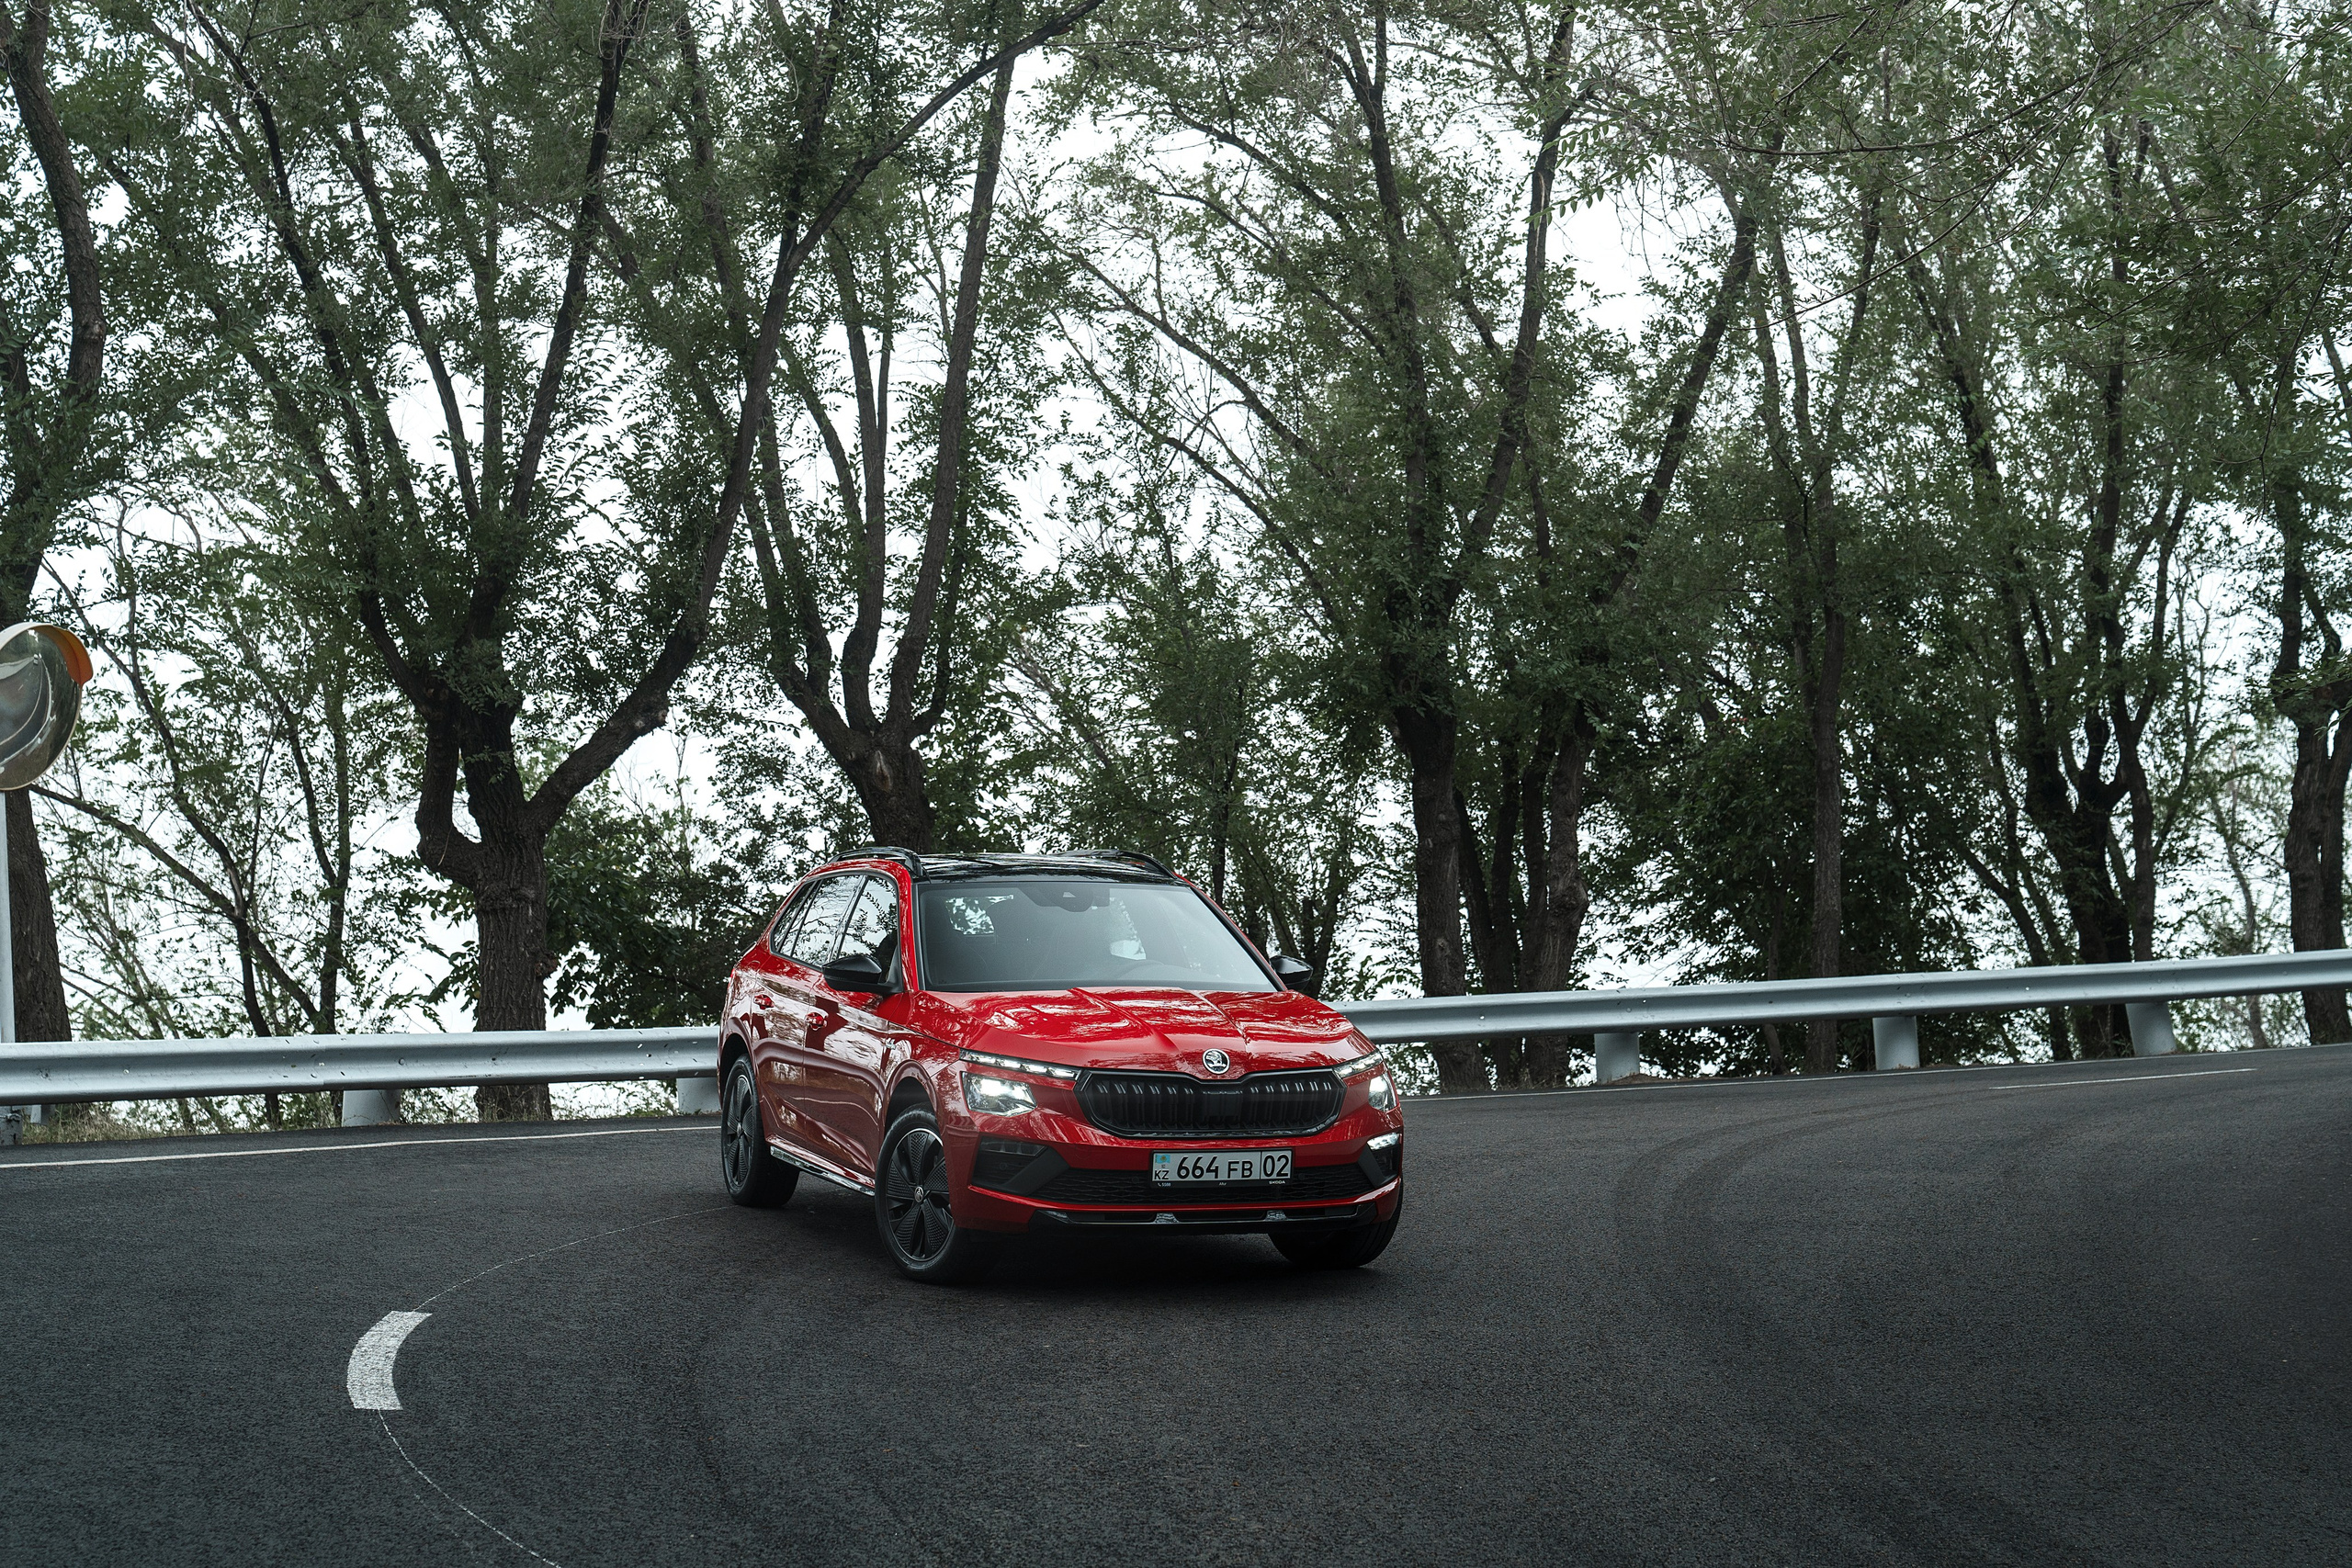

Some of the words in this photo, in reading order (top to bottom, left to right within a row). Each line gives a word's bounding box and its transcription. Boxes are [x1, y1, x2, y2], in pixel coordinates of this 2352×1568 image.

[1154, 1170, 1170, 1180] KZ
[1177, 1156, 1219, 1179] 664
[1227, 1160, 1253, 1179] FB
[1262, 1155, 1290, 1179] 02
